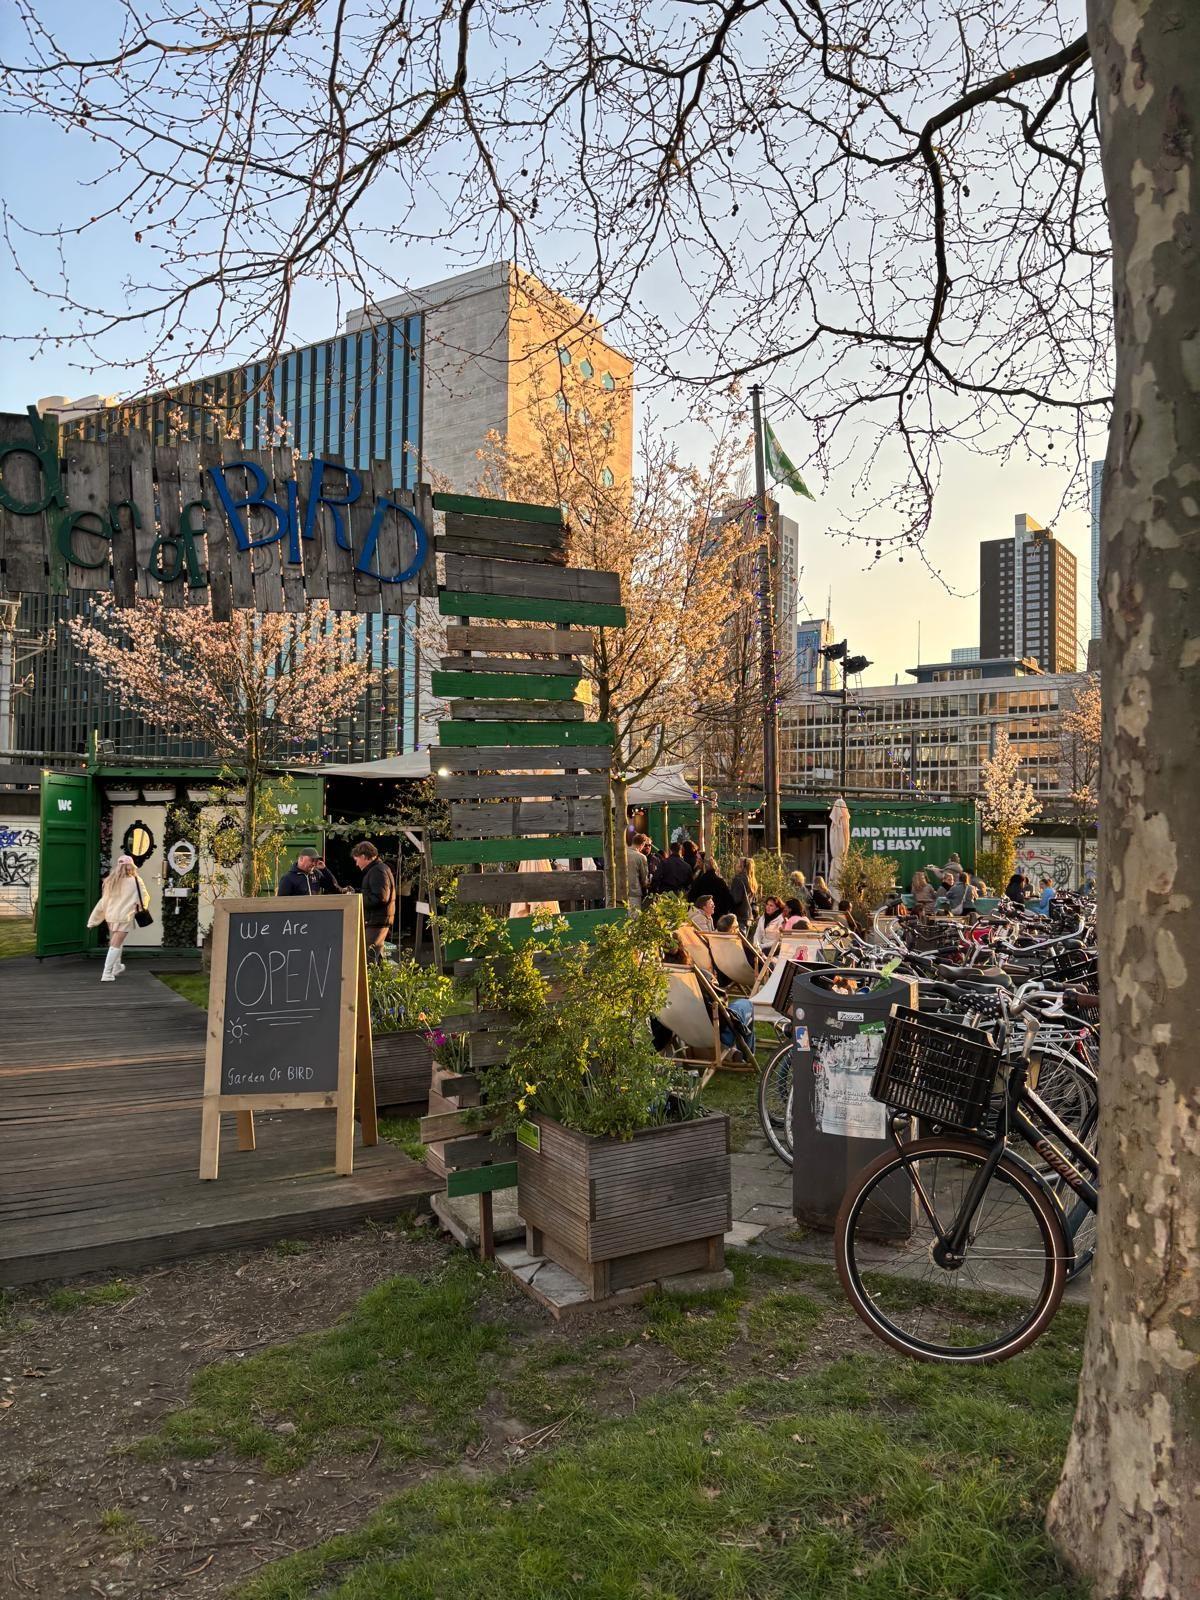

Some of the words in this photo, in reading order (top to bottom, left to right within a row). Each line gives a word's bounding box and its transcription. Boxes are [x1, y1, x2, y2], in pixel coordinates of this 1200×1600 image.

[149, 499, 211, 589] of
[207, 458, 429, 584] BIRD
[57, 798, 72, 811] WC
[277, 803, 299, 815] WC
[851, 827, 880, 838] AND
[882, 827, 907, 837] THE
[908, 826, 952, 837] LIVING
[872, 839, 885, 851] IS
[886, 839, 926, 852] EASY,
[240, 921, 270, 940] We
[282, 919, 309, 936] Are
[234, 947, 332, 1007] OPEN
[227, 1067, 265, 1086] Garden
[287, 1066, 314, 1081] BIRD
[1035, 1139, 1083, 1188] Gazelle
